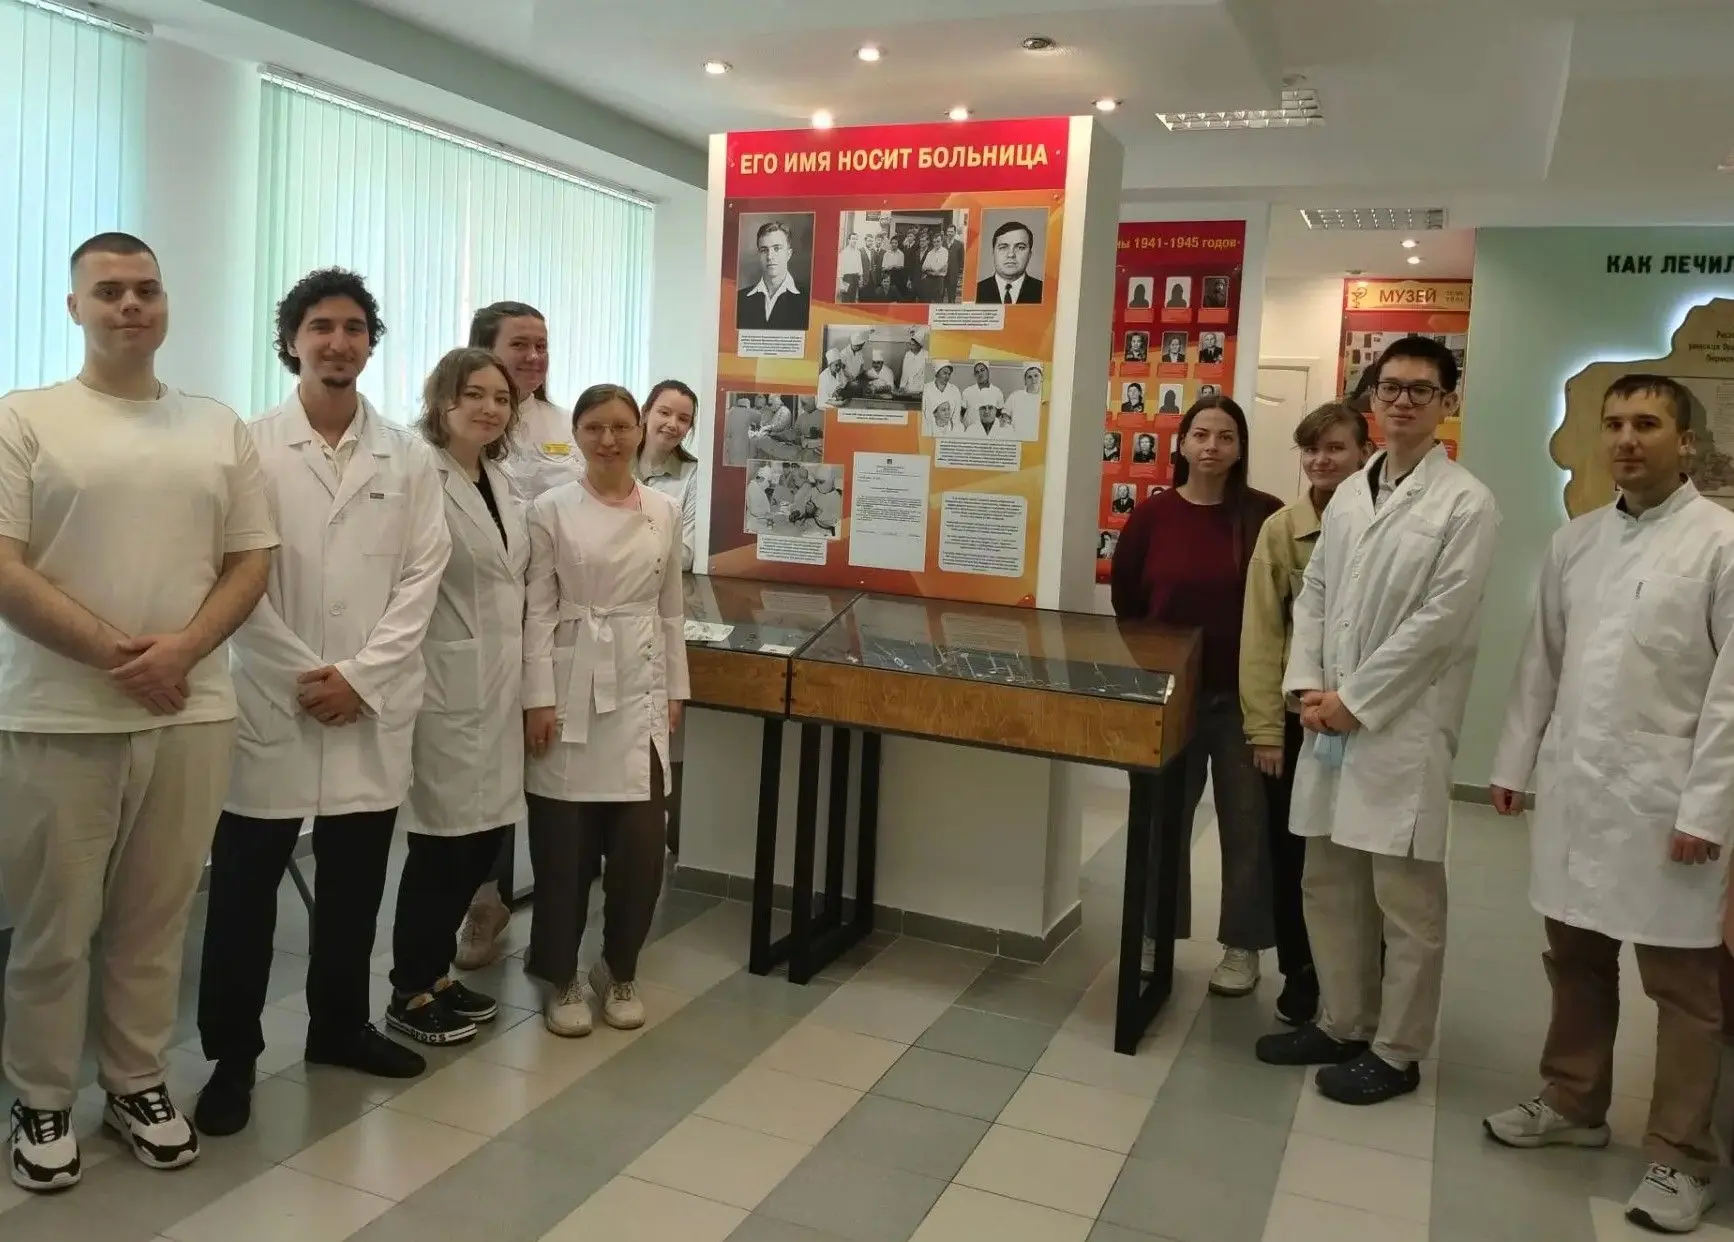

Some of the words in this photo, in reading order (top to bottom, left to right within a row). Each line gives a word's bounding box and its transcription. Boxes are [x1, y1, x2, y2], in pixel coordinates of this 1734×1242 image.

[740, 153, 778, 174] ЕГО
[784, 151, 831, 173] ИМЯ
[838, 148, 912, 171] НОСИТ
[918, 143, 1048, 170] БОЛЬНИЦА
[1202, 238, 1236, 250] годов
[1607, 255, 1652, 274] КАК
[1379, 288, 1437, 303] МУЗЕЙ
